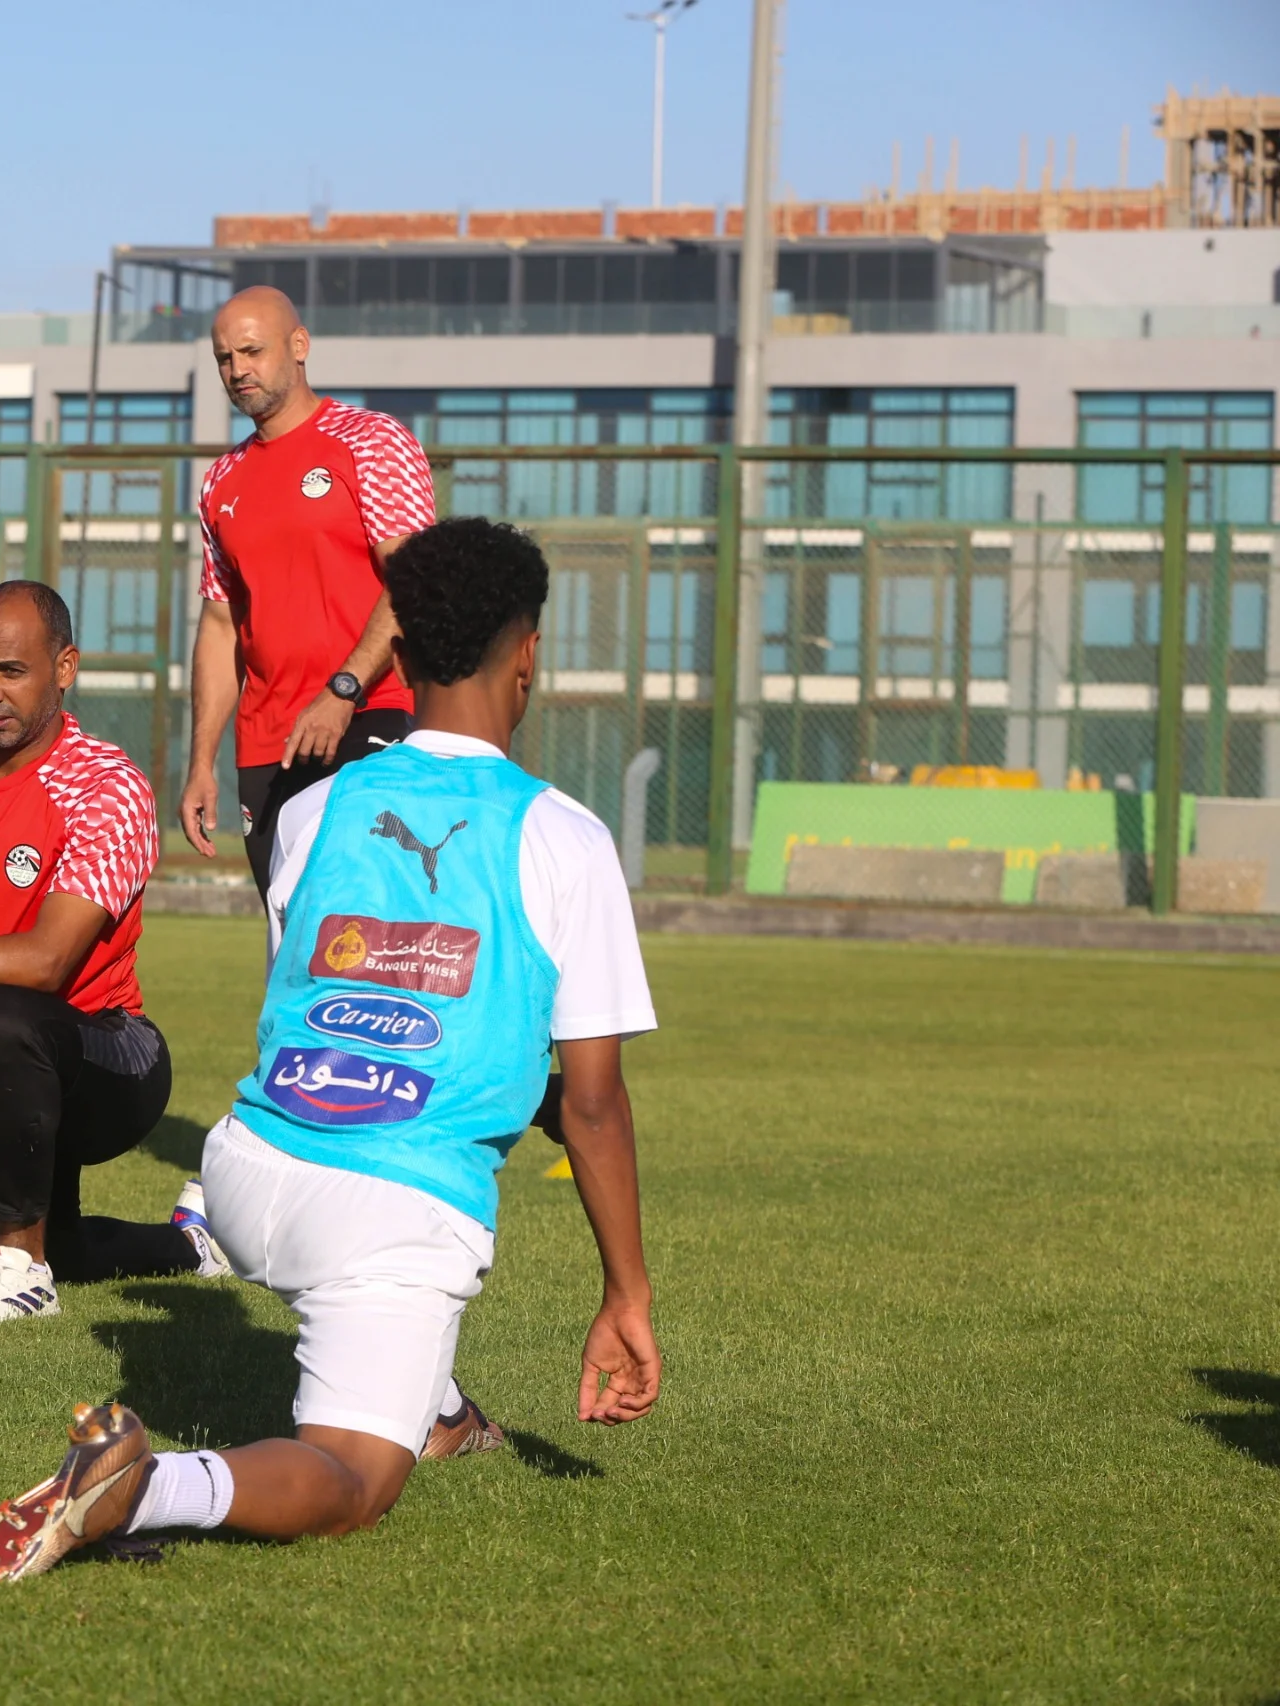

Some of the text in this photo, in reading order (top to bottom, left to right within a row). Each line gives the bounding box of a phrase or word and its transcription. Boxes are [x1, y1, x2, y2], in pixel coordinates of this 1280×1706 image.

[370, 938, 466, 964] بنك مصر
[364, 957, 460, 979] BANQUE MISR
[321, 1002, 425, 1037] Carrier
[274, 1054, 419, 1102] دانون
